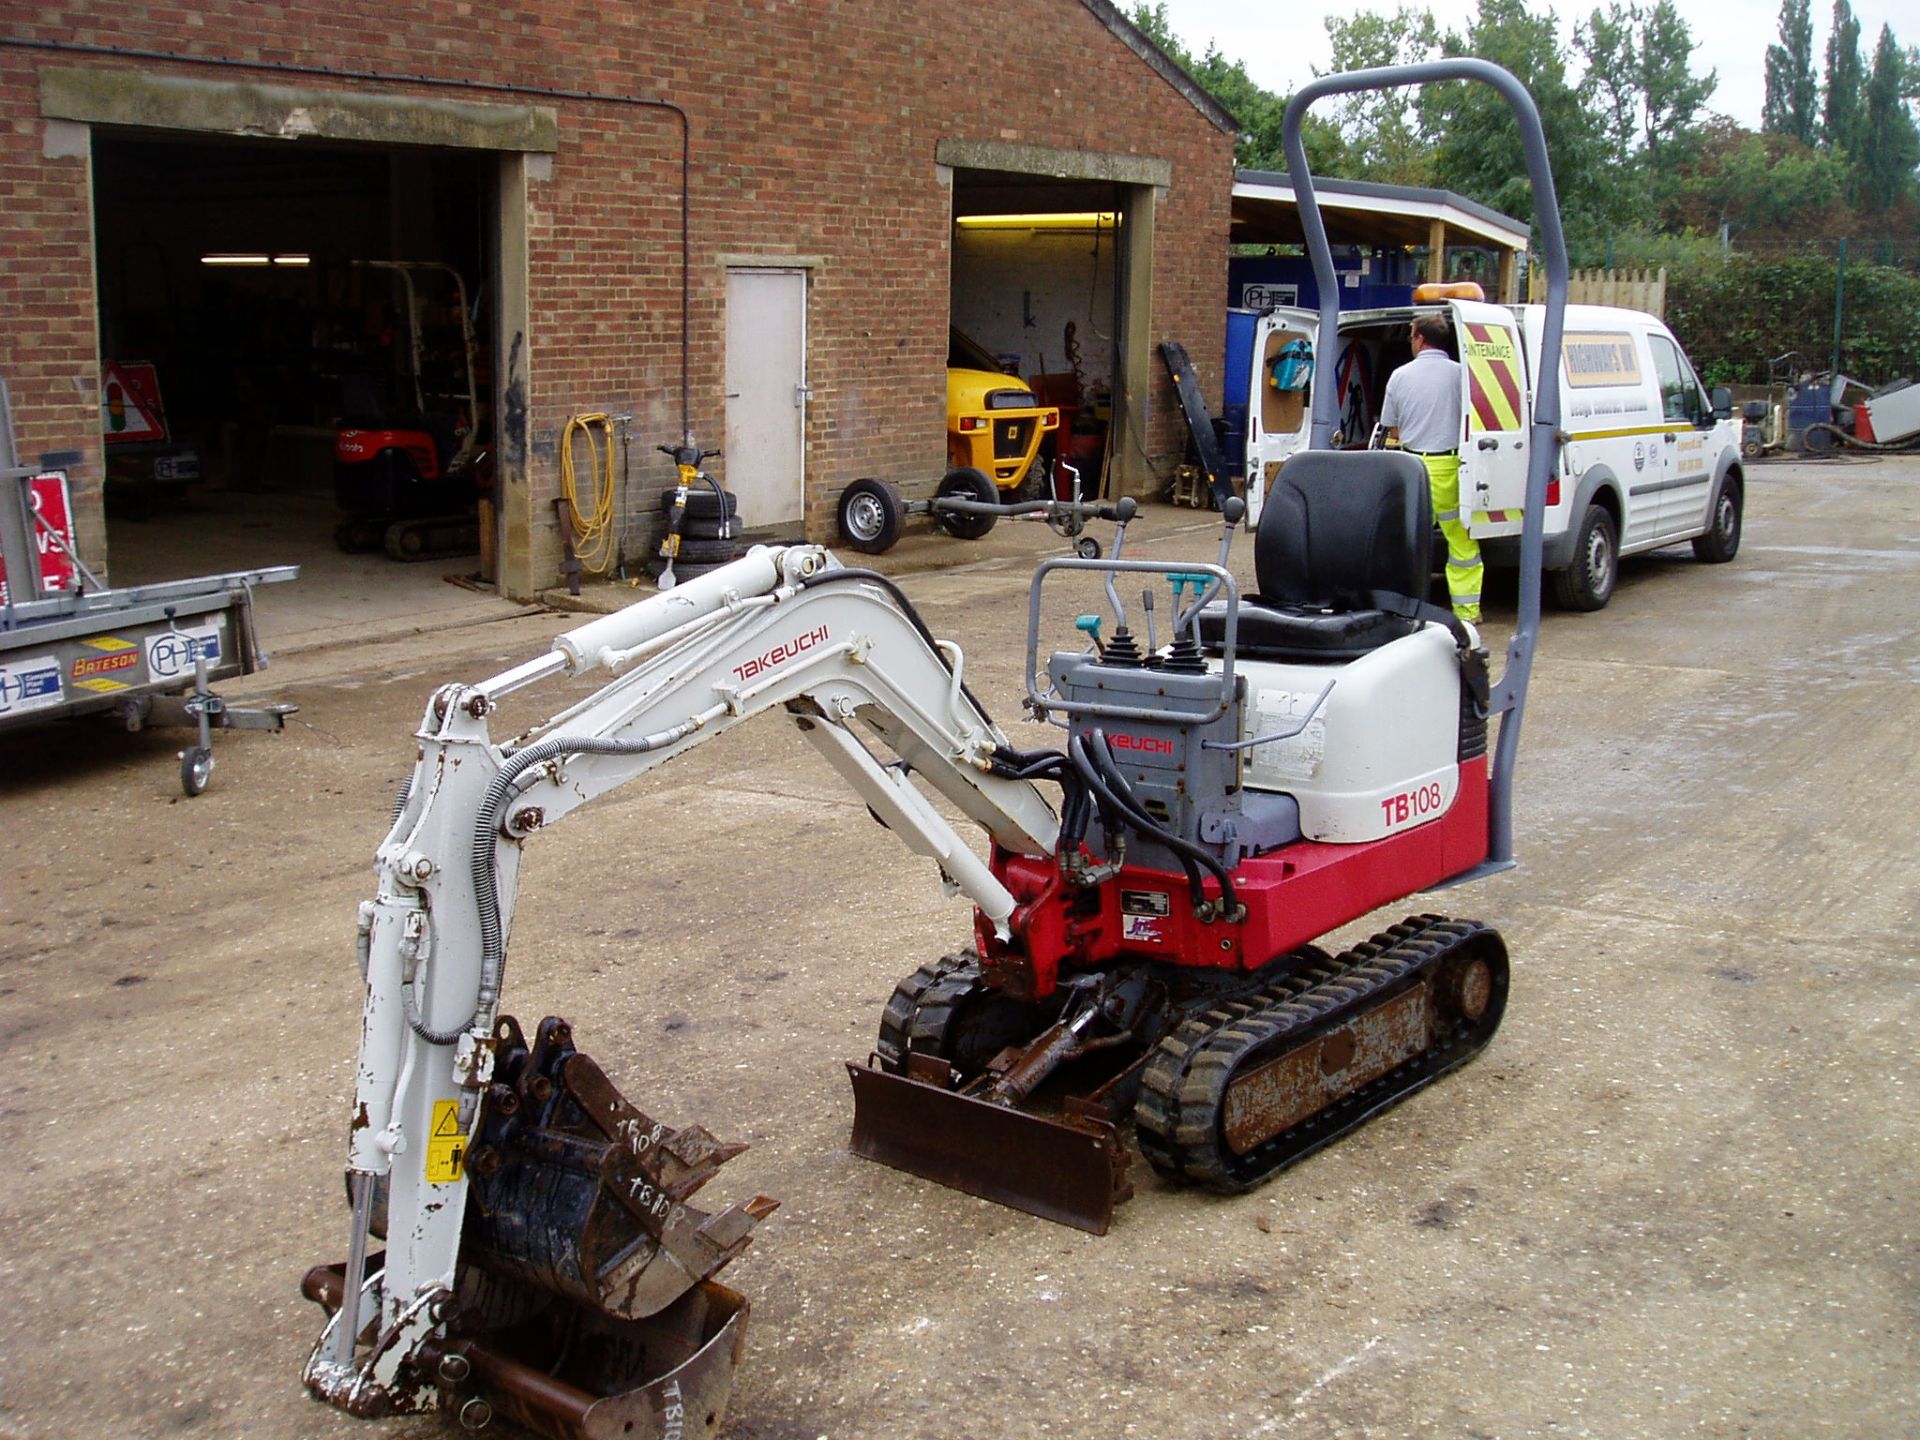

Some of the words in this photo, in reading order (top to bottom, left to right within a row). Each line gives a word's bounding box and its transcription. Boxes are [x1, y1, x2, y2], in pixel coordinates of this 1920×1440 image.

[74, 654, 138, 676] BATESON
[733, 625, 830, 681] TAKEUCHI
[1083, 728, 1173, 754] KEUCHI
[1381, 782, 1441, 827] TB108
